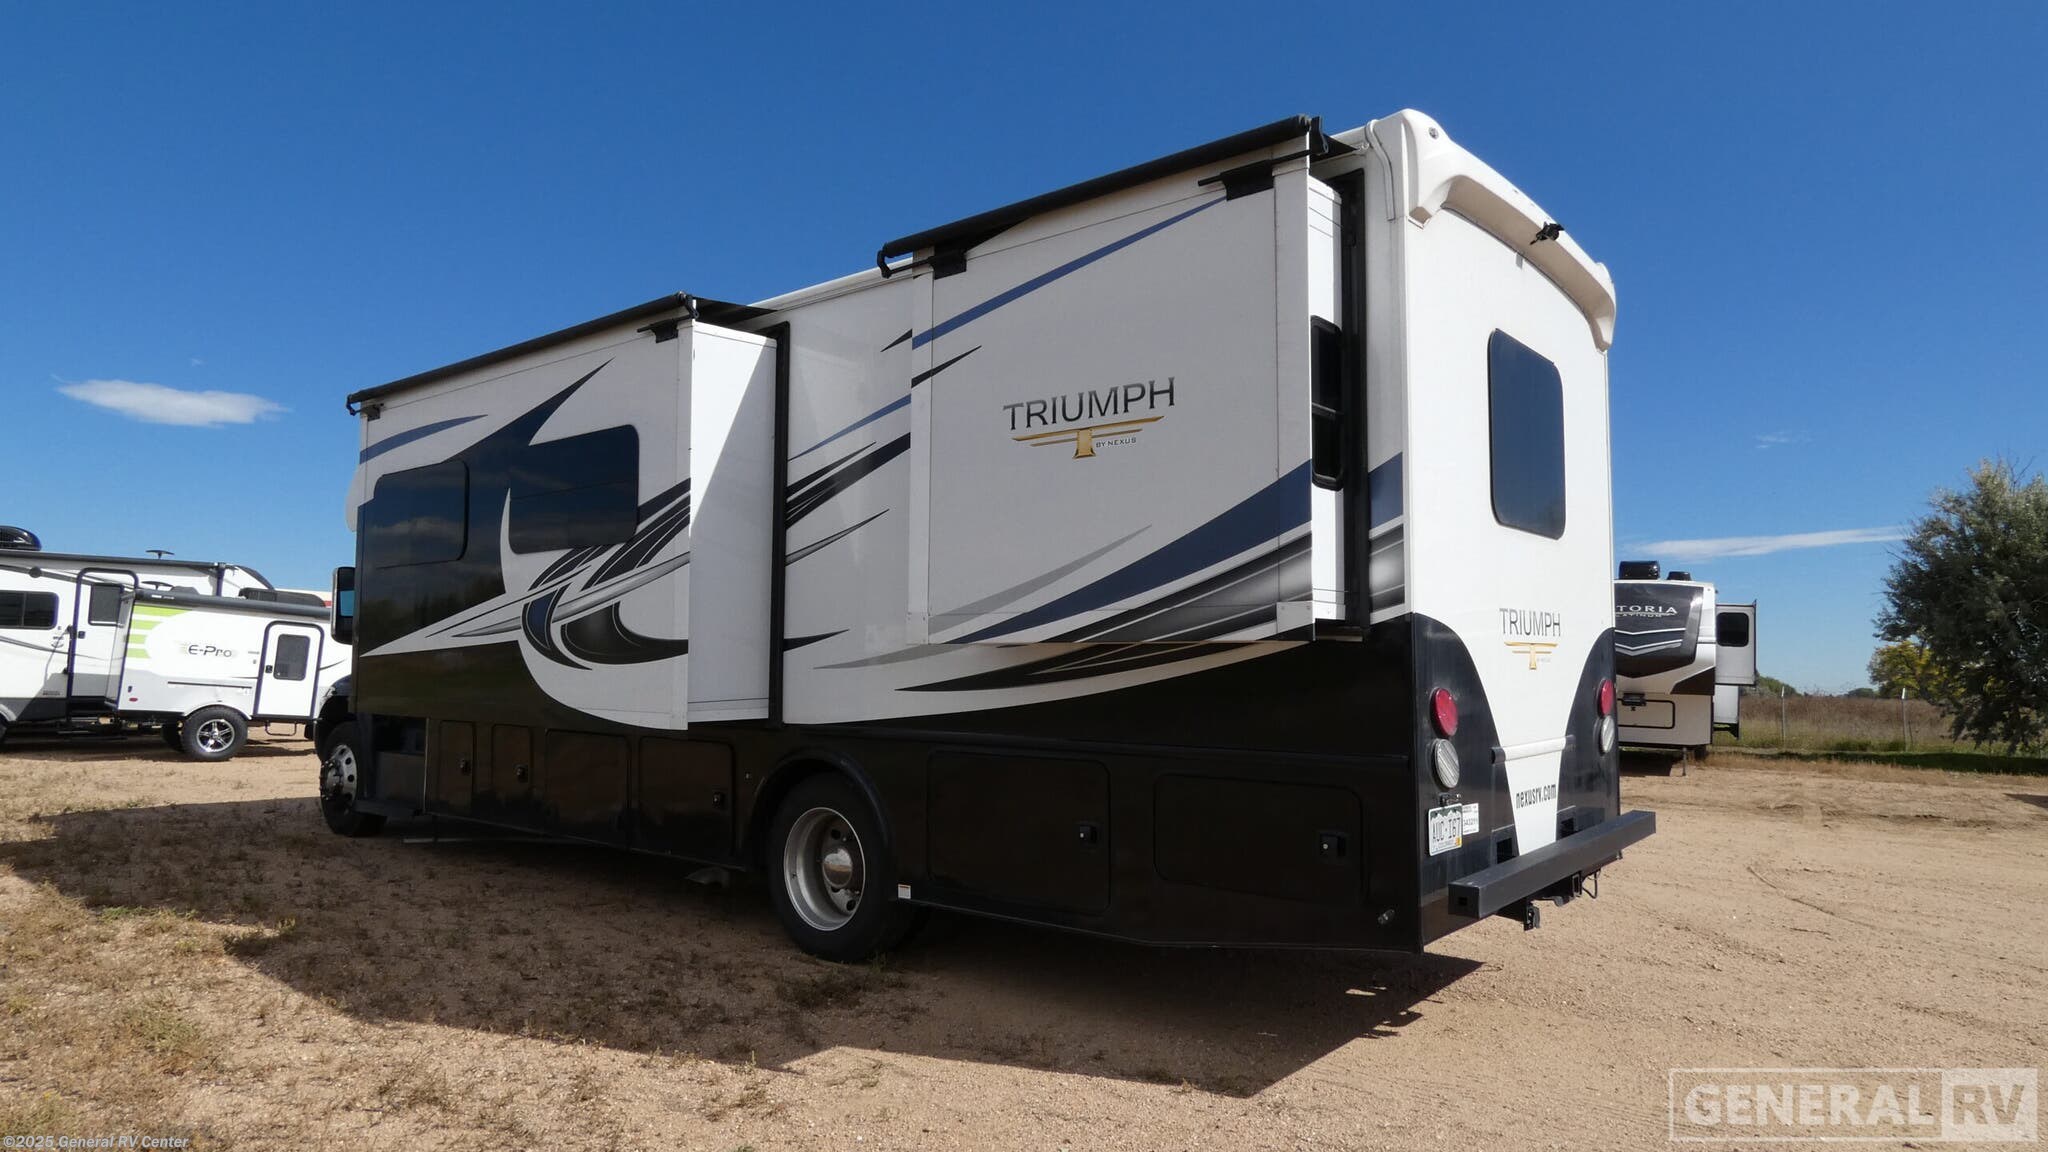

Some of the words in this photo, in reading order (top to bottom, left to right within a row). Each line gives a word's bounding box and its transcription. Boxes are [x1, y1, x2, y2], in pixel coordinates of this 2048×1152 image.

[1003, 376, 1175, 431] TRIUMPH
[1107, 437, 1137, 446] NEXUS
[1499, 607, 1561, 637] TRIUMPH
[188, 644, 232, 658] E-Pro
[1516, 784, 1557, 809] nexusrv.com
